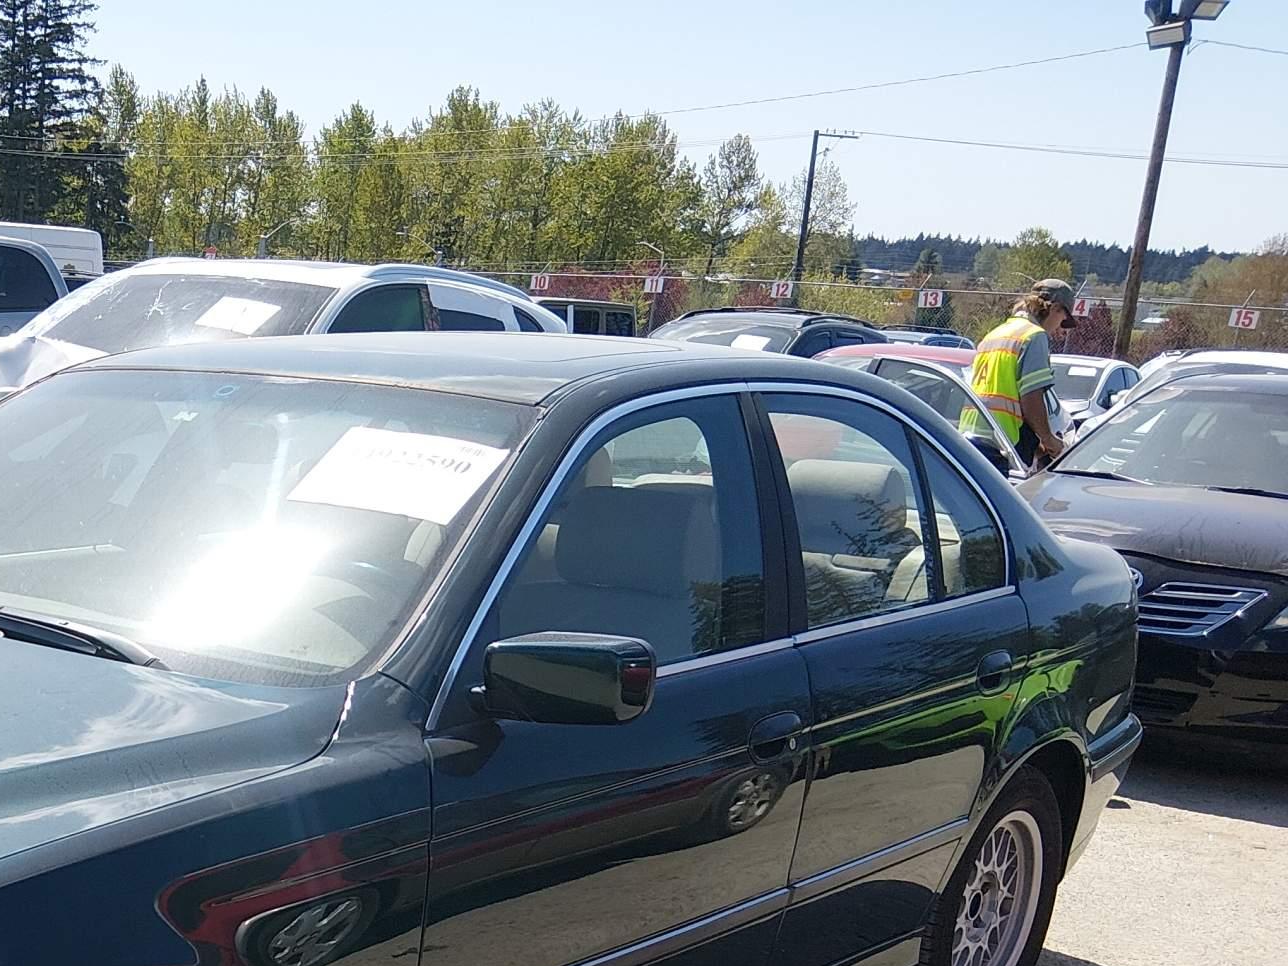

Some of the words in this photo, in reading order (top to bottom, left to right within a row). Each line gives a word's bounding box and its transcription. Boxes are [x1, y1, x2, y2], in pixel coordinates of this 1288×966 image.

[534, 275, 547, 289] 10
[649, 278, 659, 292] 11
[774, 283, 789, 297] 12
[923, 292, 939, 307] 13
[1074, 299, 1086, 315] 4
[1234, 309, 1255, 328] 15
